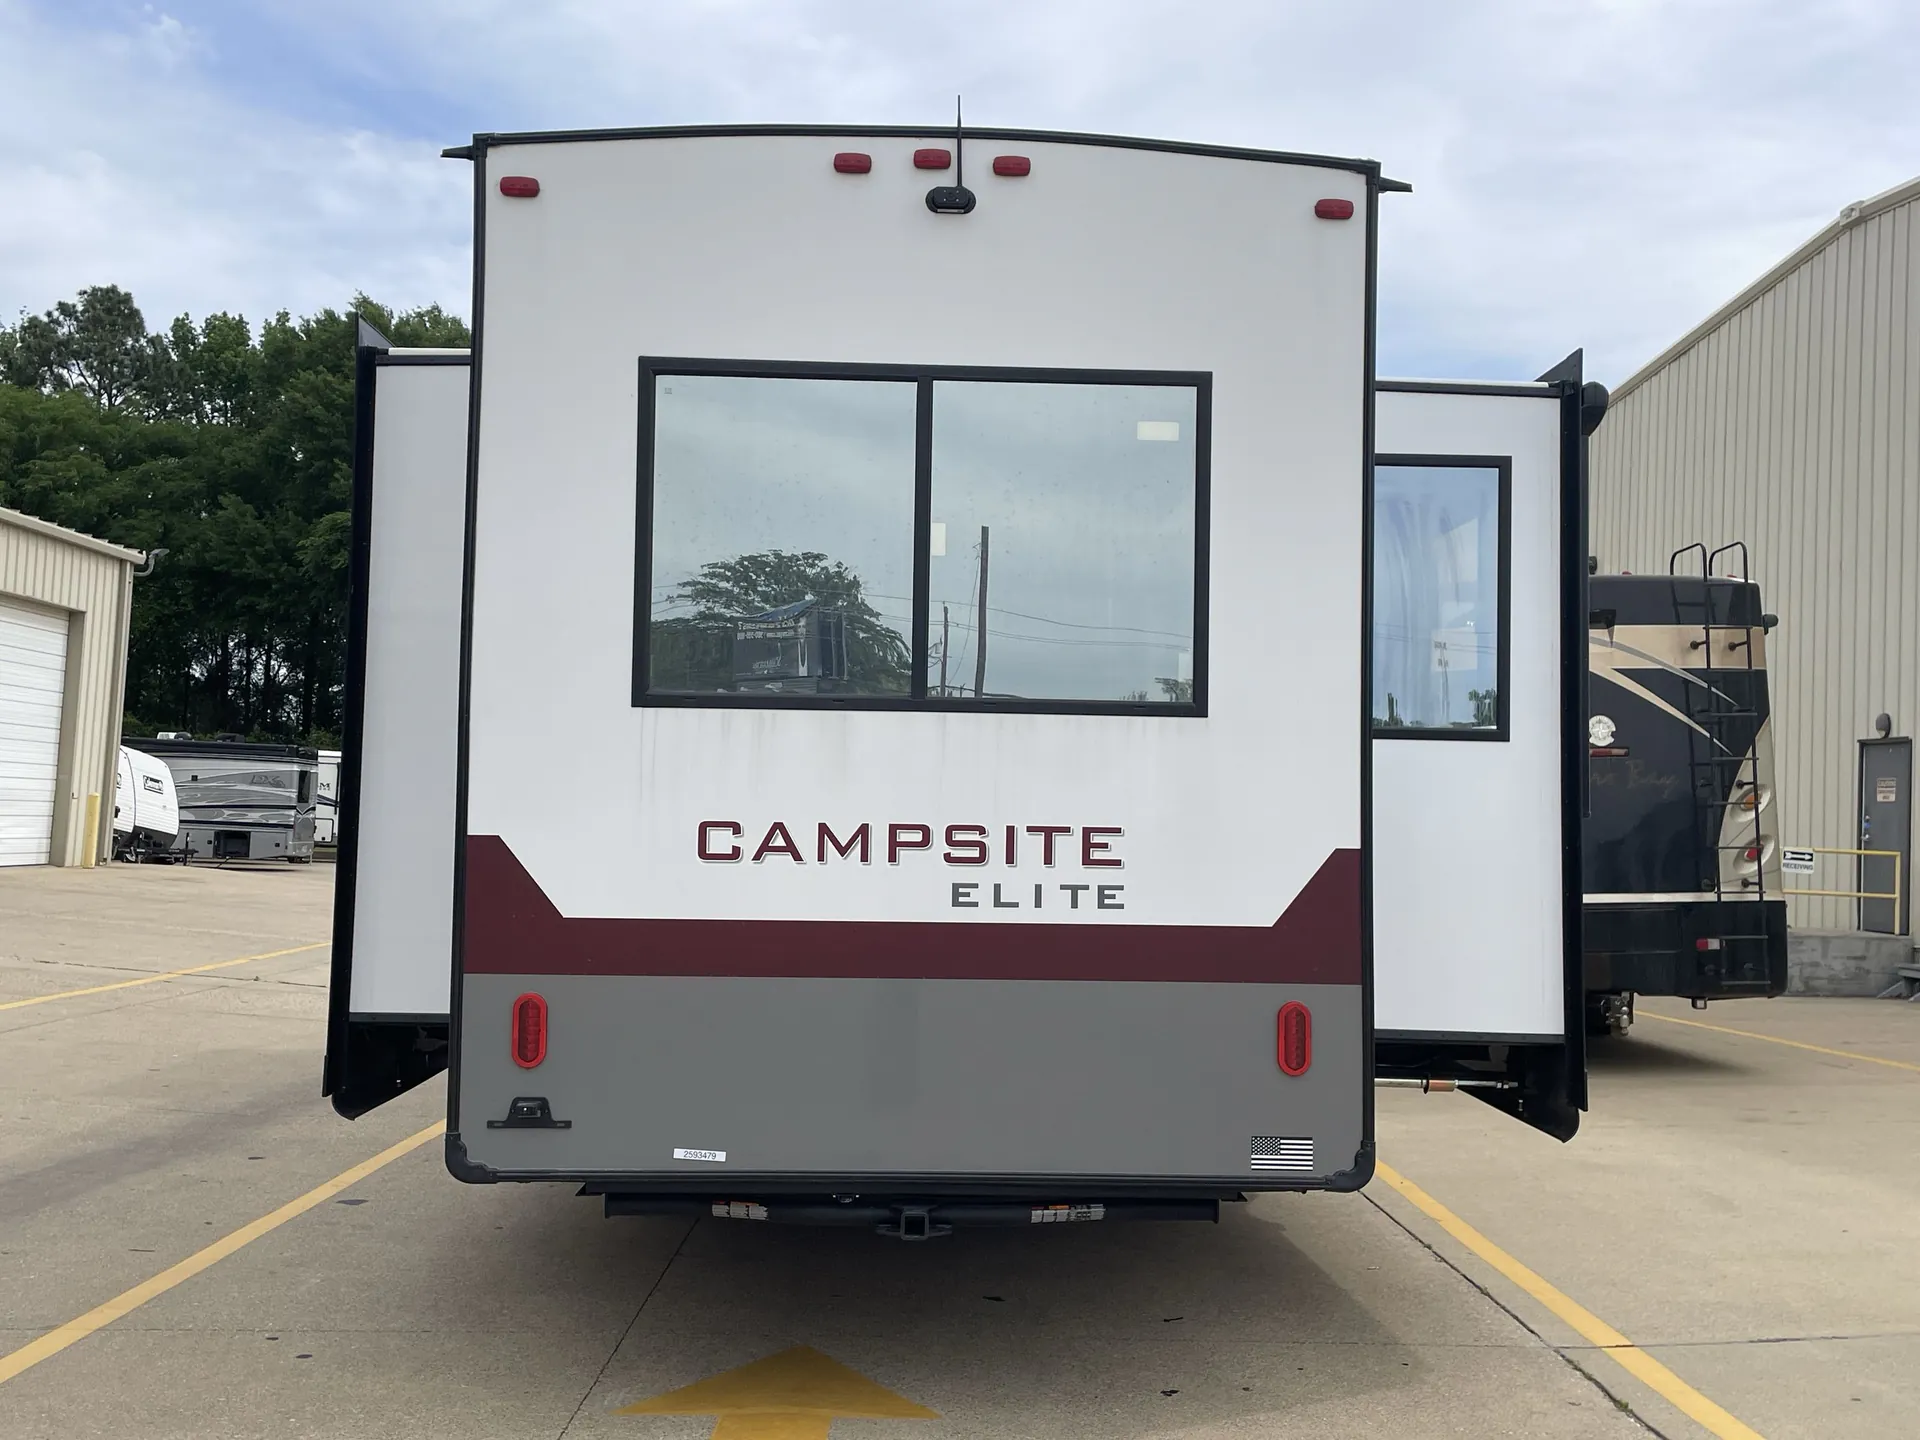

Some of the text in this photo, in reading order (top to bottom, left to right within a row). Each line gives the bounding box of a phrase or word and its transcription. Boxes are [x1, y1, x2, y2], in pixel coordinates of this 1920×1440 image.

[697, 820, 1125, 868] CAMPSITE
[1782, 862, 1814, 871] RECEIVING
[951, 882, 1125, 910] ELITE
[683, 1150, 717, 1160] 2593479
